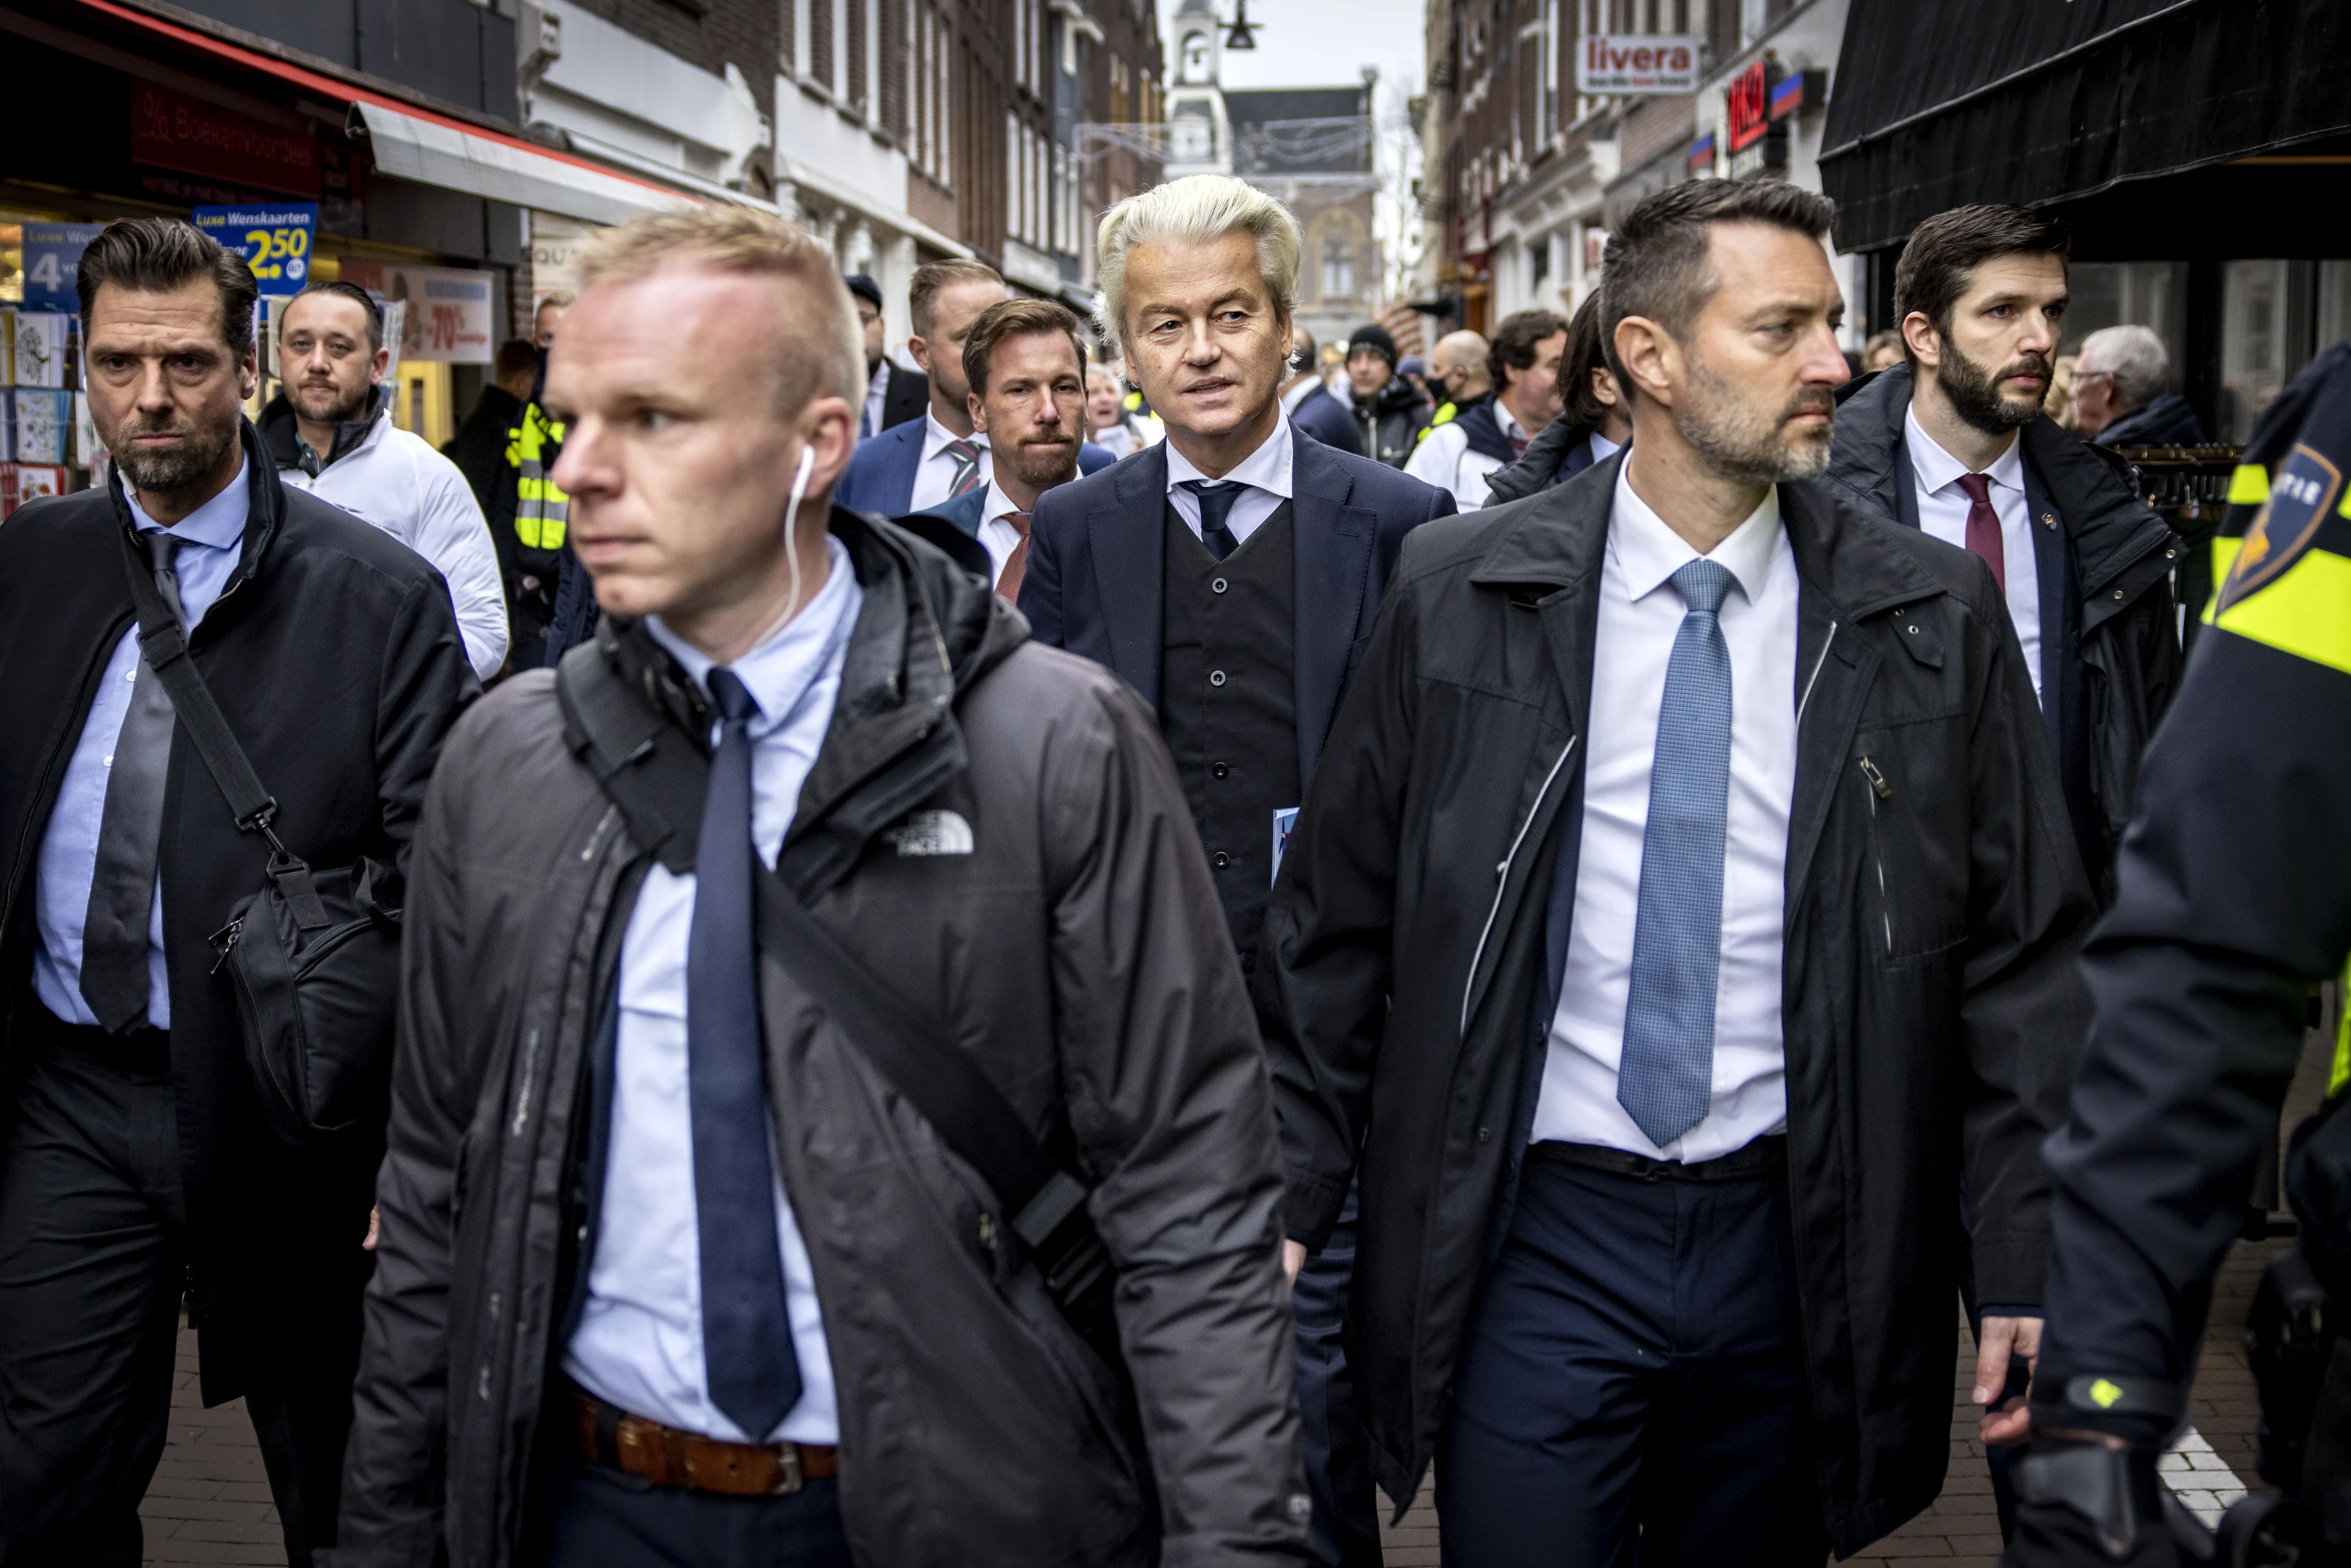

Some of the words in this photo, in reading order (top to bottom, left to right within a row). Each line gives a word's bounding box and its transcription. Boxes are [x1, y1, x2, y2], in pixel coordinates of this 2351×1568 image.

[1588, 39, 1690, 71] livera
[195, 213, 225, 226] Luxe
[227, 211, 311, 226] Wenskaarten
[29, 230, 62, 242] Luxe
[30, 253, 61, 292] 4
